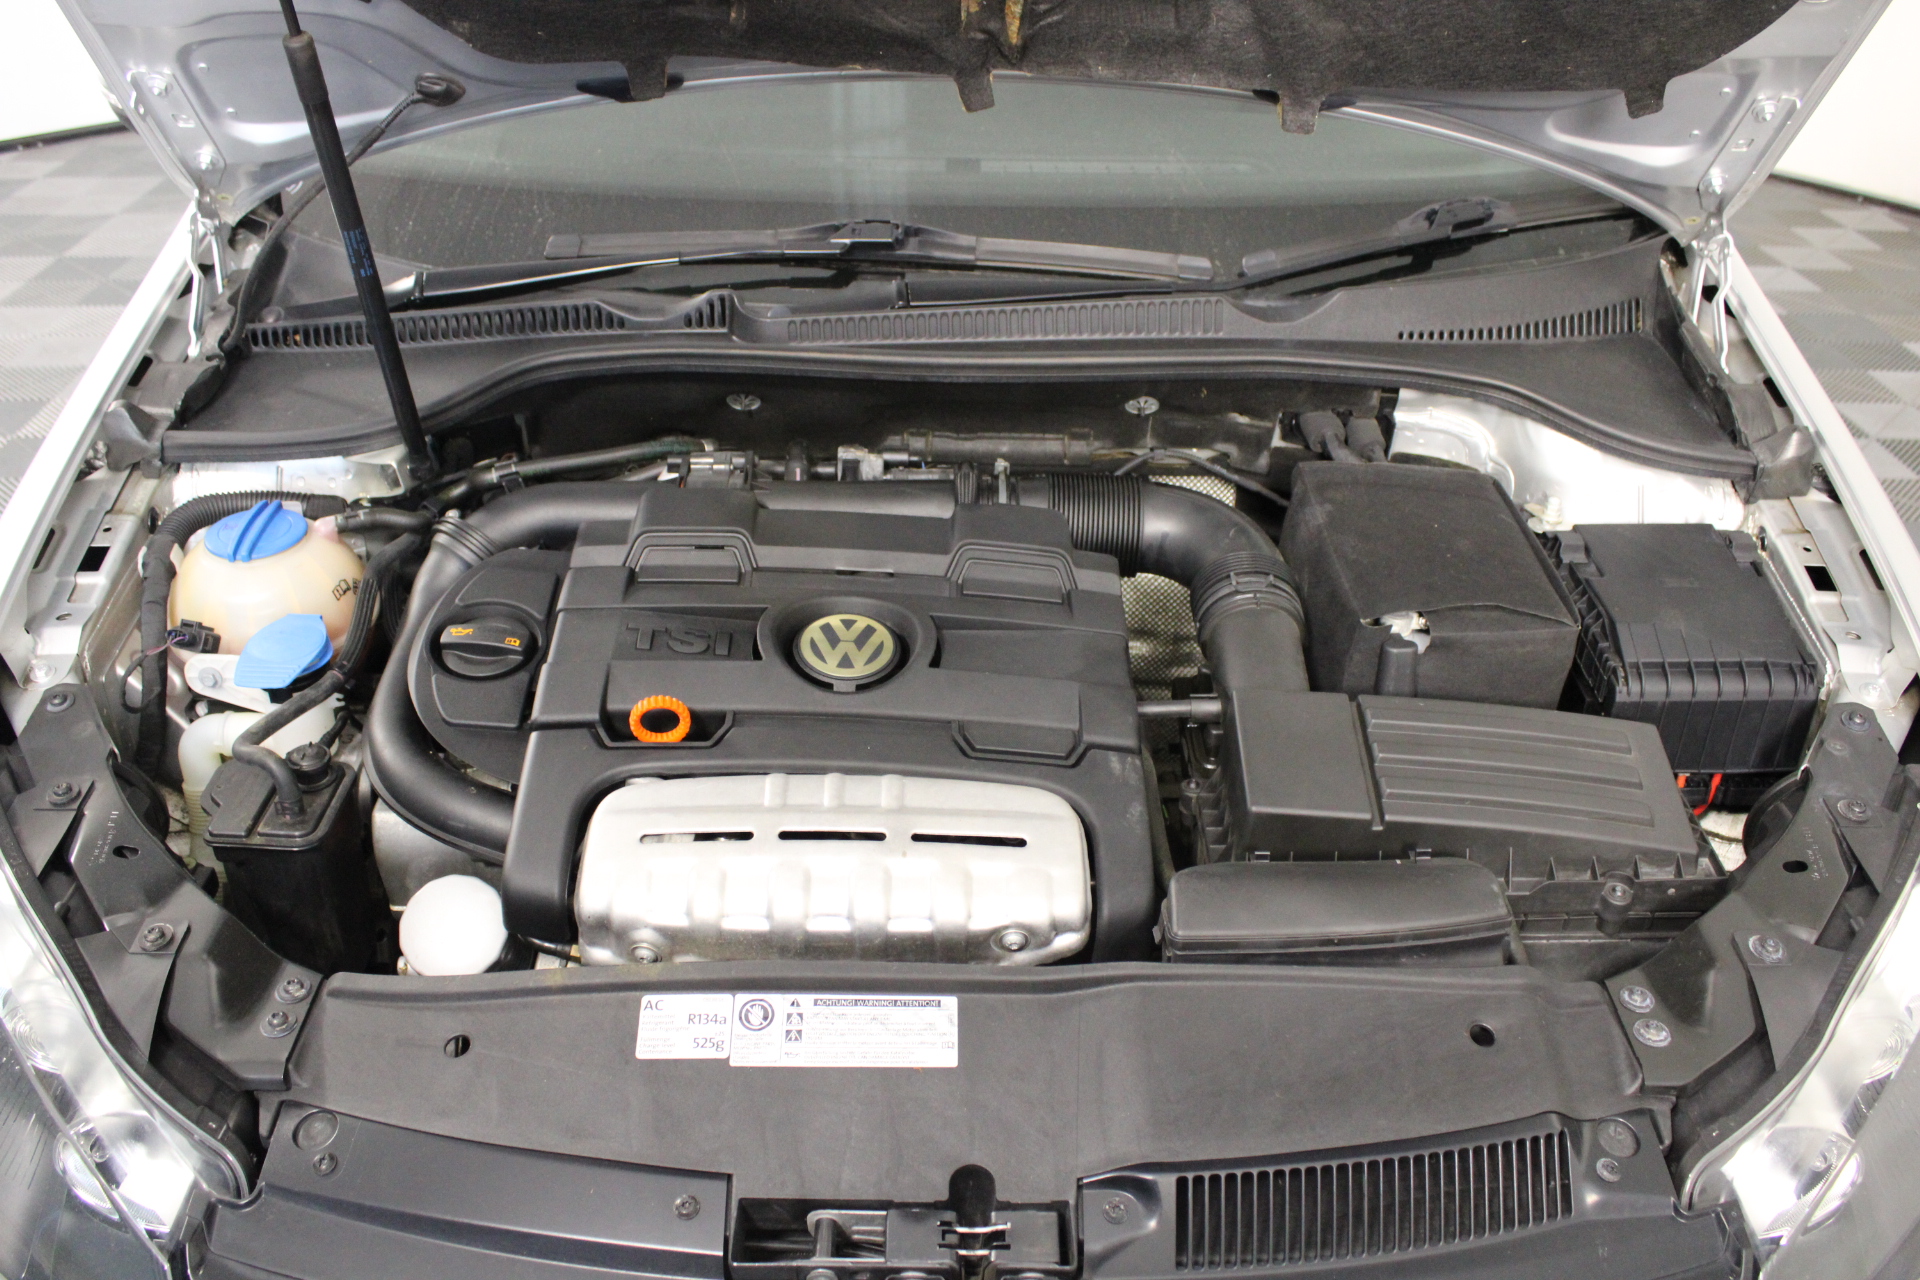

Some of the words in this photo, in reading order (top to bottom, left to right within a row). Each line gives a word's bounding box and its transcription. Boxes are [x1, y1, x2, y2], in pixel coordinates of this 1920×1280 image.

[626, 623, 733, 656] TSI
[644, 1000, 664, 1011] AC
[816, 999, 855, 1007] ACHTUNG!
[856, 999, 895, 1007] WARNING!
[688, 1014, 727, 1025] R134a
[692, 1037, 725, 1052] 525g
